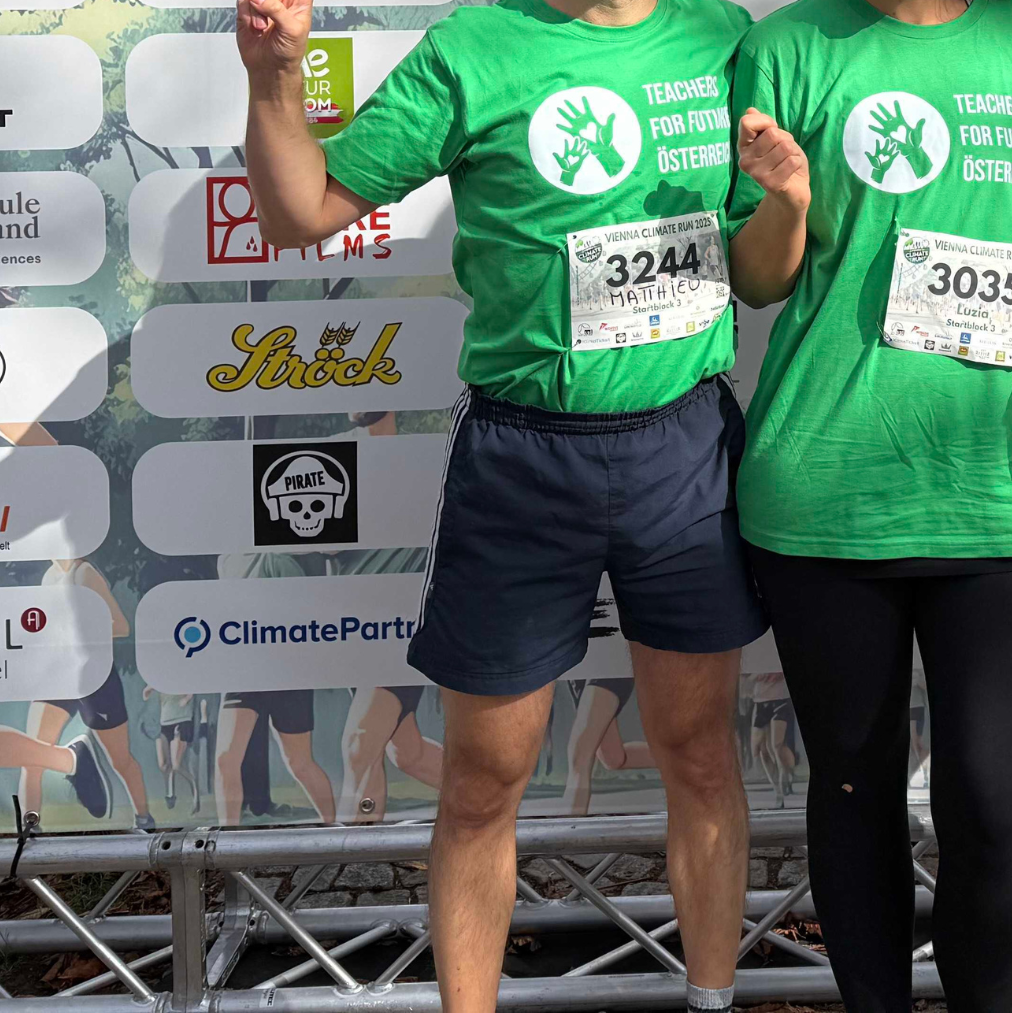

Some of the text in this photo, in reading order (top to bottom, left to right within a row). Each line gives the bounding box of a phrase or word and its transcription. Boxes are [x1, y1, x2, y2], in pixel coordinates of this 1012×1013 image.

[641, 75, 720, 106] TEACHERS
[649, 114, 686, 140] FOR
[959, 125, 994, 146] FOR
[605, 216, 712, 243] VIENNA CLIMATE RUN 2025
[934, 239, 968, 254] VIENNA
[969, 245, 1004, 259] CLIMATE
[605, 242, 701, 288] 3244
[632, 298, 682, 314] Startblock 3
[956, 303, 989, 319] Luzia
[946, 318, 996, 333] Startblock 3
[206, 321, 403, 393] Ströck
[284, 470, 326, 492] PIRATE
